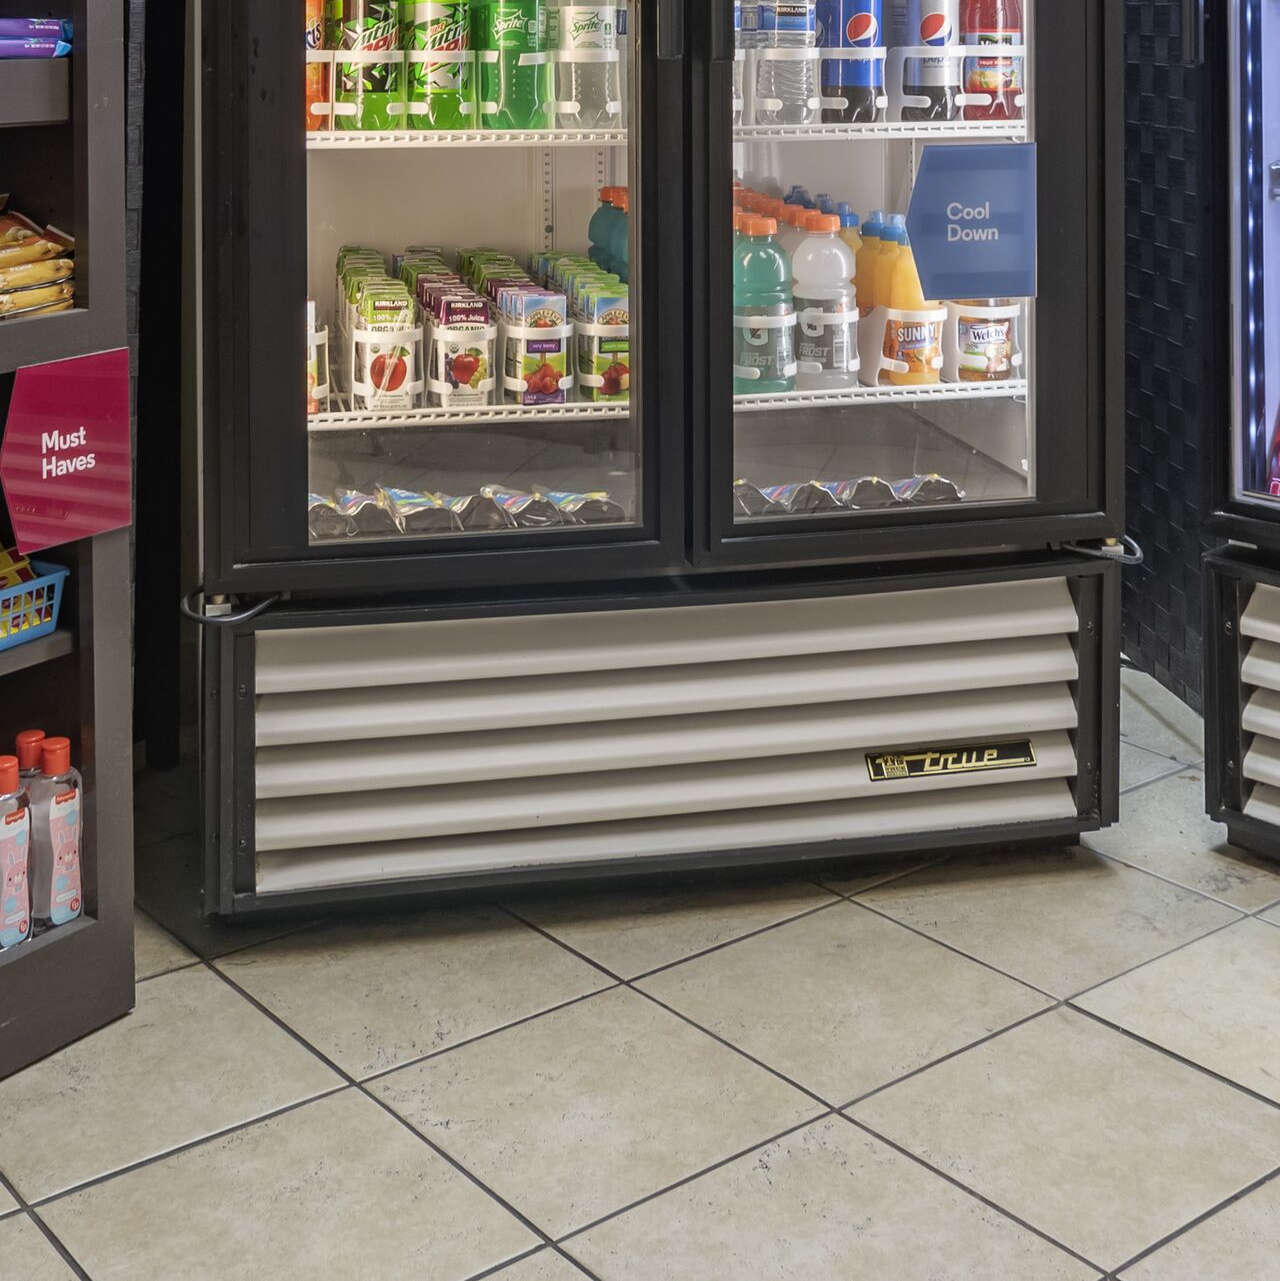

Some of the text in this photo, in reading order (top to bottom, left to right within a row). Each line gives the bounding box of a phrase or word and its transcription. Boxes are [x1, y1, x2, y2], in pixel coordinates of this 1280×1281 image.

[777, 6, 807, 14] KIRKLAND
[493, 17, 528, 35] Sprite
[571, 18, 605, 35] Sprite
[947, 202, 990, 220] Cool
[947, 224, 999, 241] Down
[375, 301, 408, 309] KIRKLAND
[449, 314, 485, 322] 100% Juice
[897, 323, 936, 342] SUNNY
[971, 328, 1006, 342] Welch's
[543, 343, 556, 351] berry
[799, 347, 831, 357] FROST
[42, 426, 86, 454] Must
[42, 449, 96, 479] Haves
